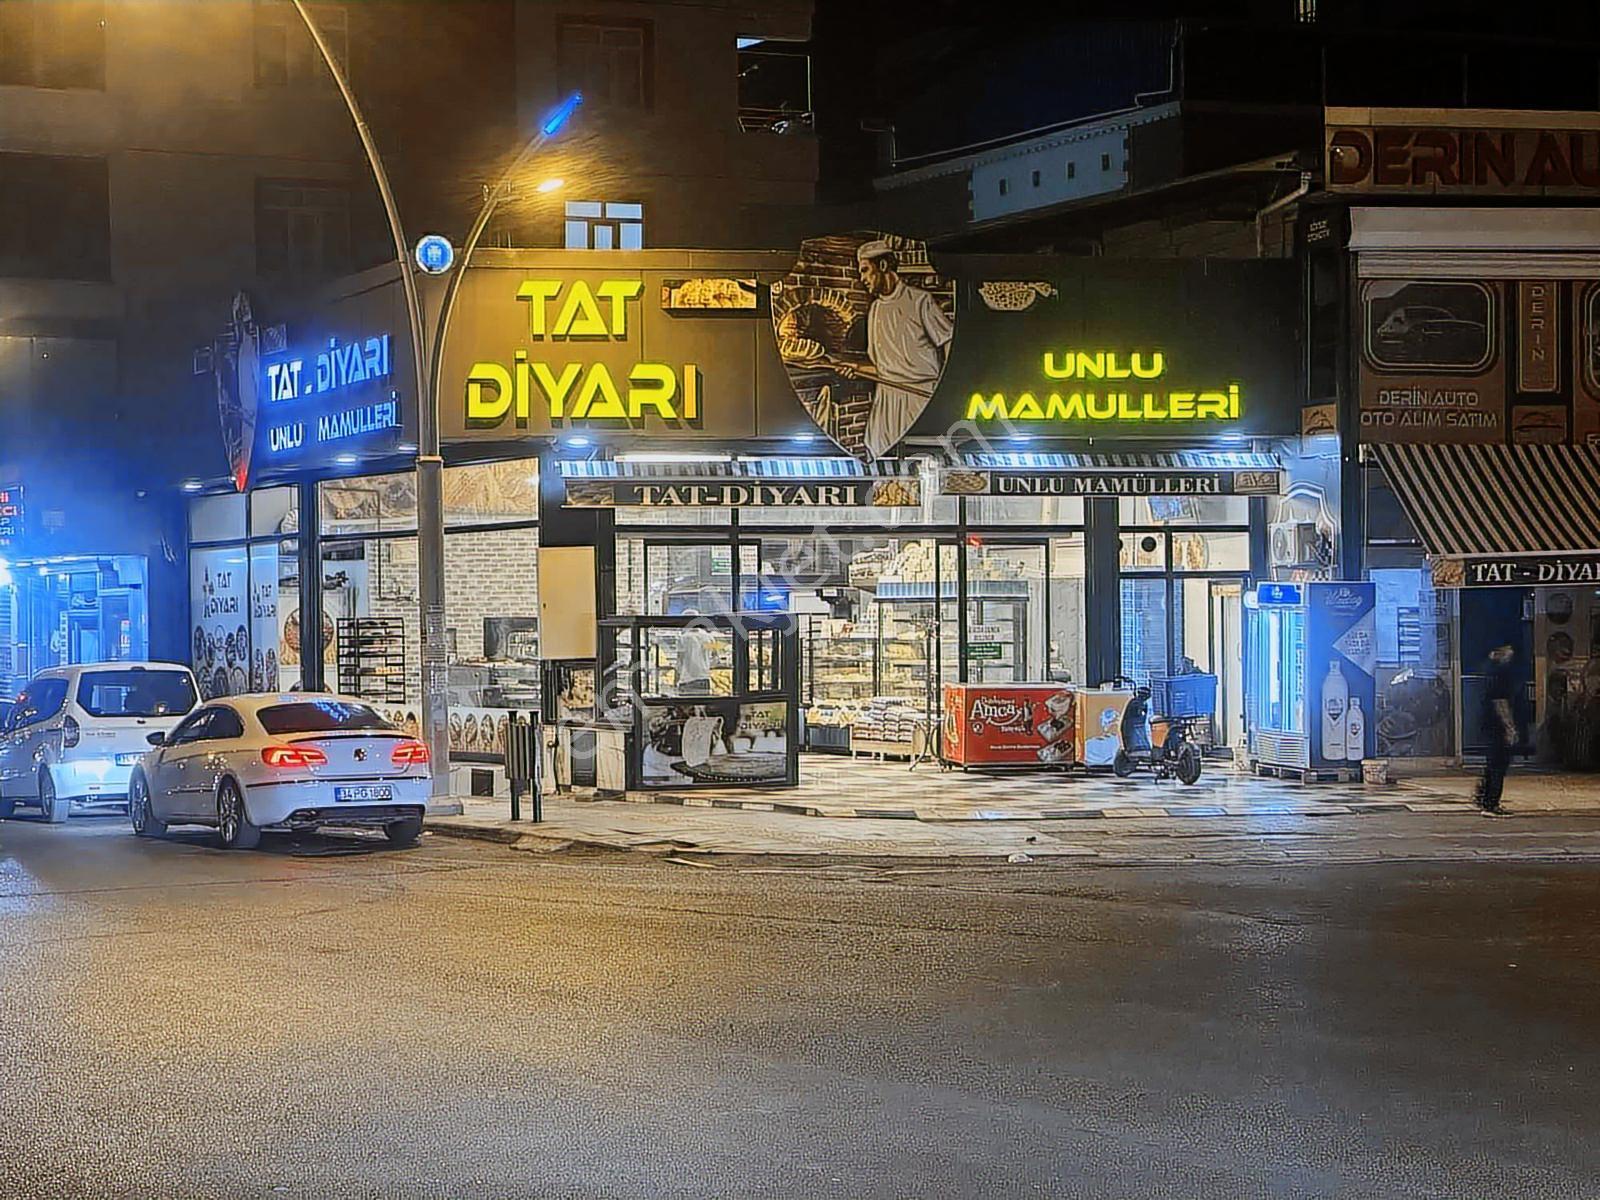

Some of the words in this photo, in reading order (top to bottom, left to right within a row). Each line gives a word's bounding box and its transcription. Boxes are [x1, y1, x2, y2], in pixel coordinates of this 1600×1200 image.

[516, 280, 643, 337] TAT
[267, 360, 303, 402] TAT
[316, 334, 389, 393] DİYARI
[1043, 352, 1164, 380] UNLU
[467, 349, 698, 419] DİYARI
[966, 384, 1240, 421] MAMULLERİ
[1431, 391, 1479, 406] AUTO
[269, 422, 304, 451] UNLU
[317, 390, 397, 441] MAMULLERİ
[1360, 411, 1395, 427] OTO
[1400, 411, 1441, 428] ALIM
[1446, 412, 1498, 428] SATIM
[634, 481, 858, 506] TAT-DİYARI
[998, 476, 1065, 494] UNLU
[1073, 473, 1222, 495] MAMÜLLERİ
[216, 570, 232, 588] TAT
[1471, 563, 1517, 582] TAT
[1537, 559, 1600, 581] DİYA
